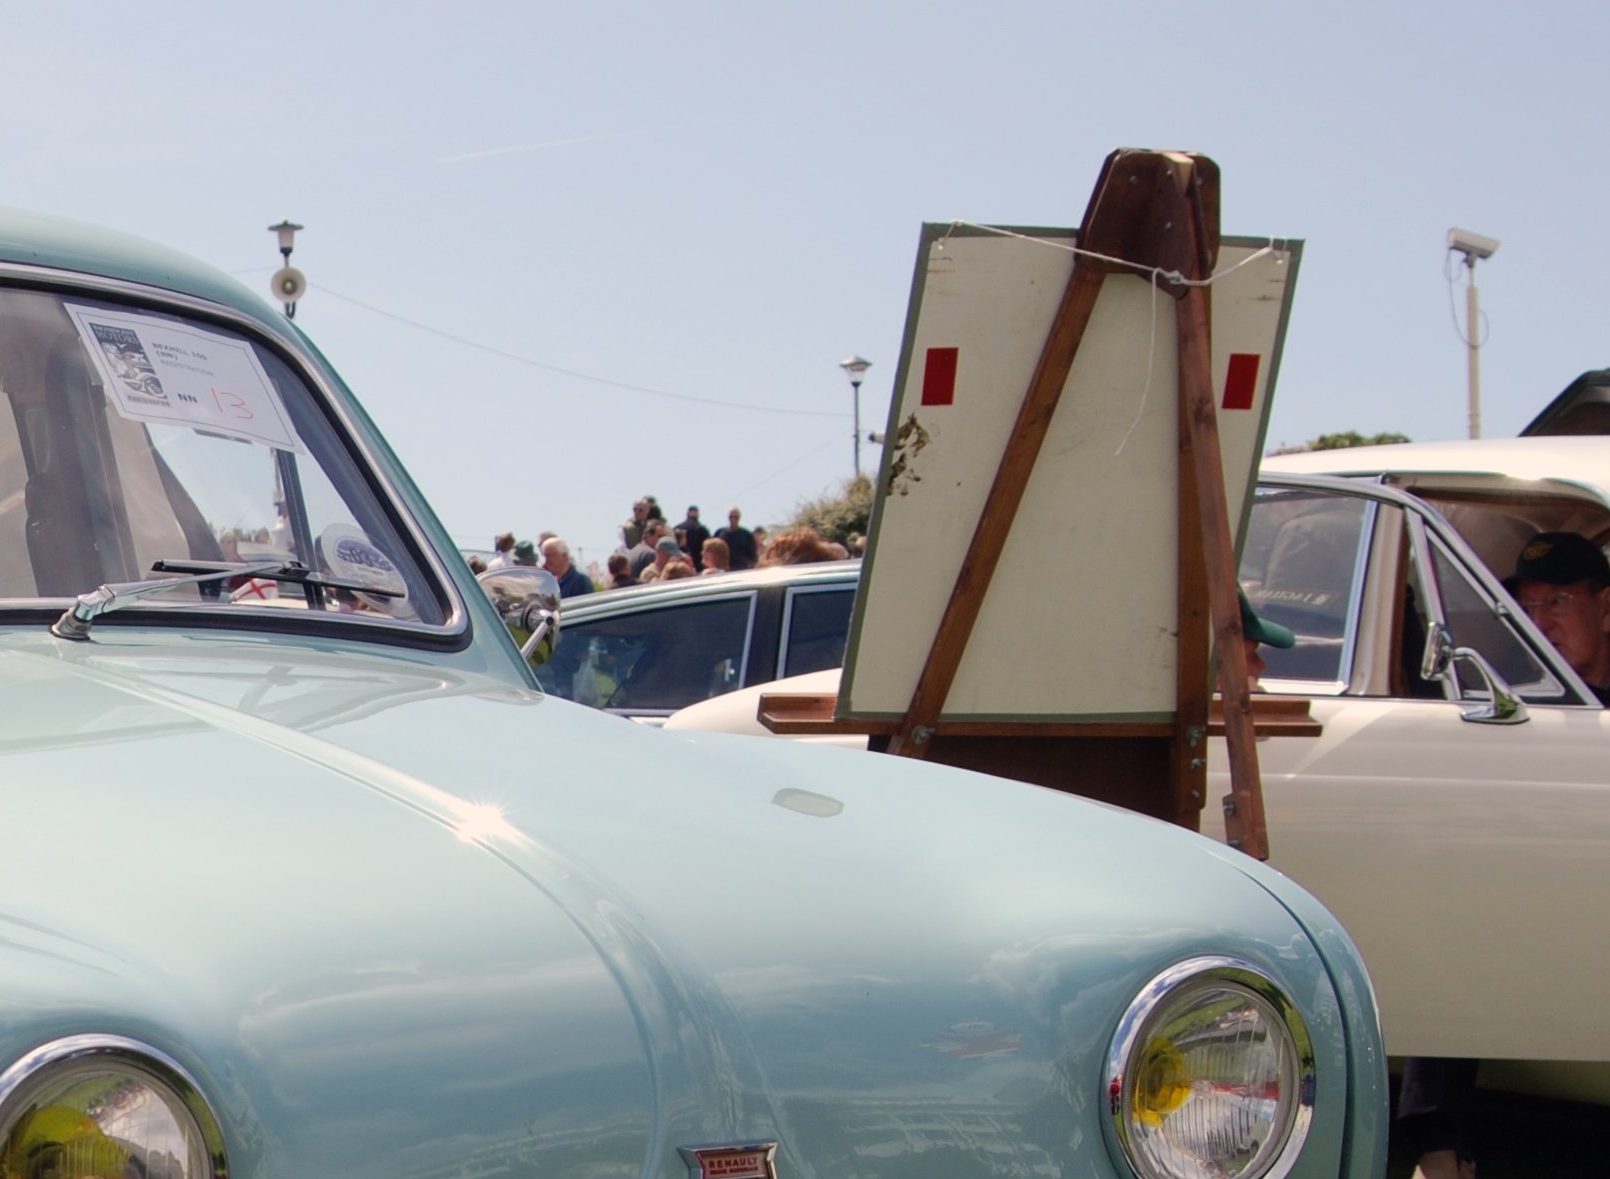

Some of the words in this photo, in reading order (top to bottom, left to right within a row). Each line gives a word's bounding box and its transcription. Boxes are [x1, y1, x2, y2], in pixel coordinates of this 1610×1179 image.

[177, 393, 198, 404] NN
[210, 387, 254, 420] 13
[709, 1157, 758, 1169] RENAULT
